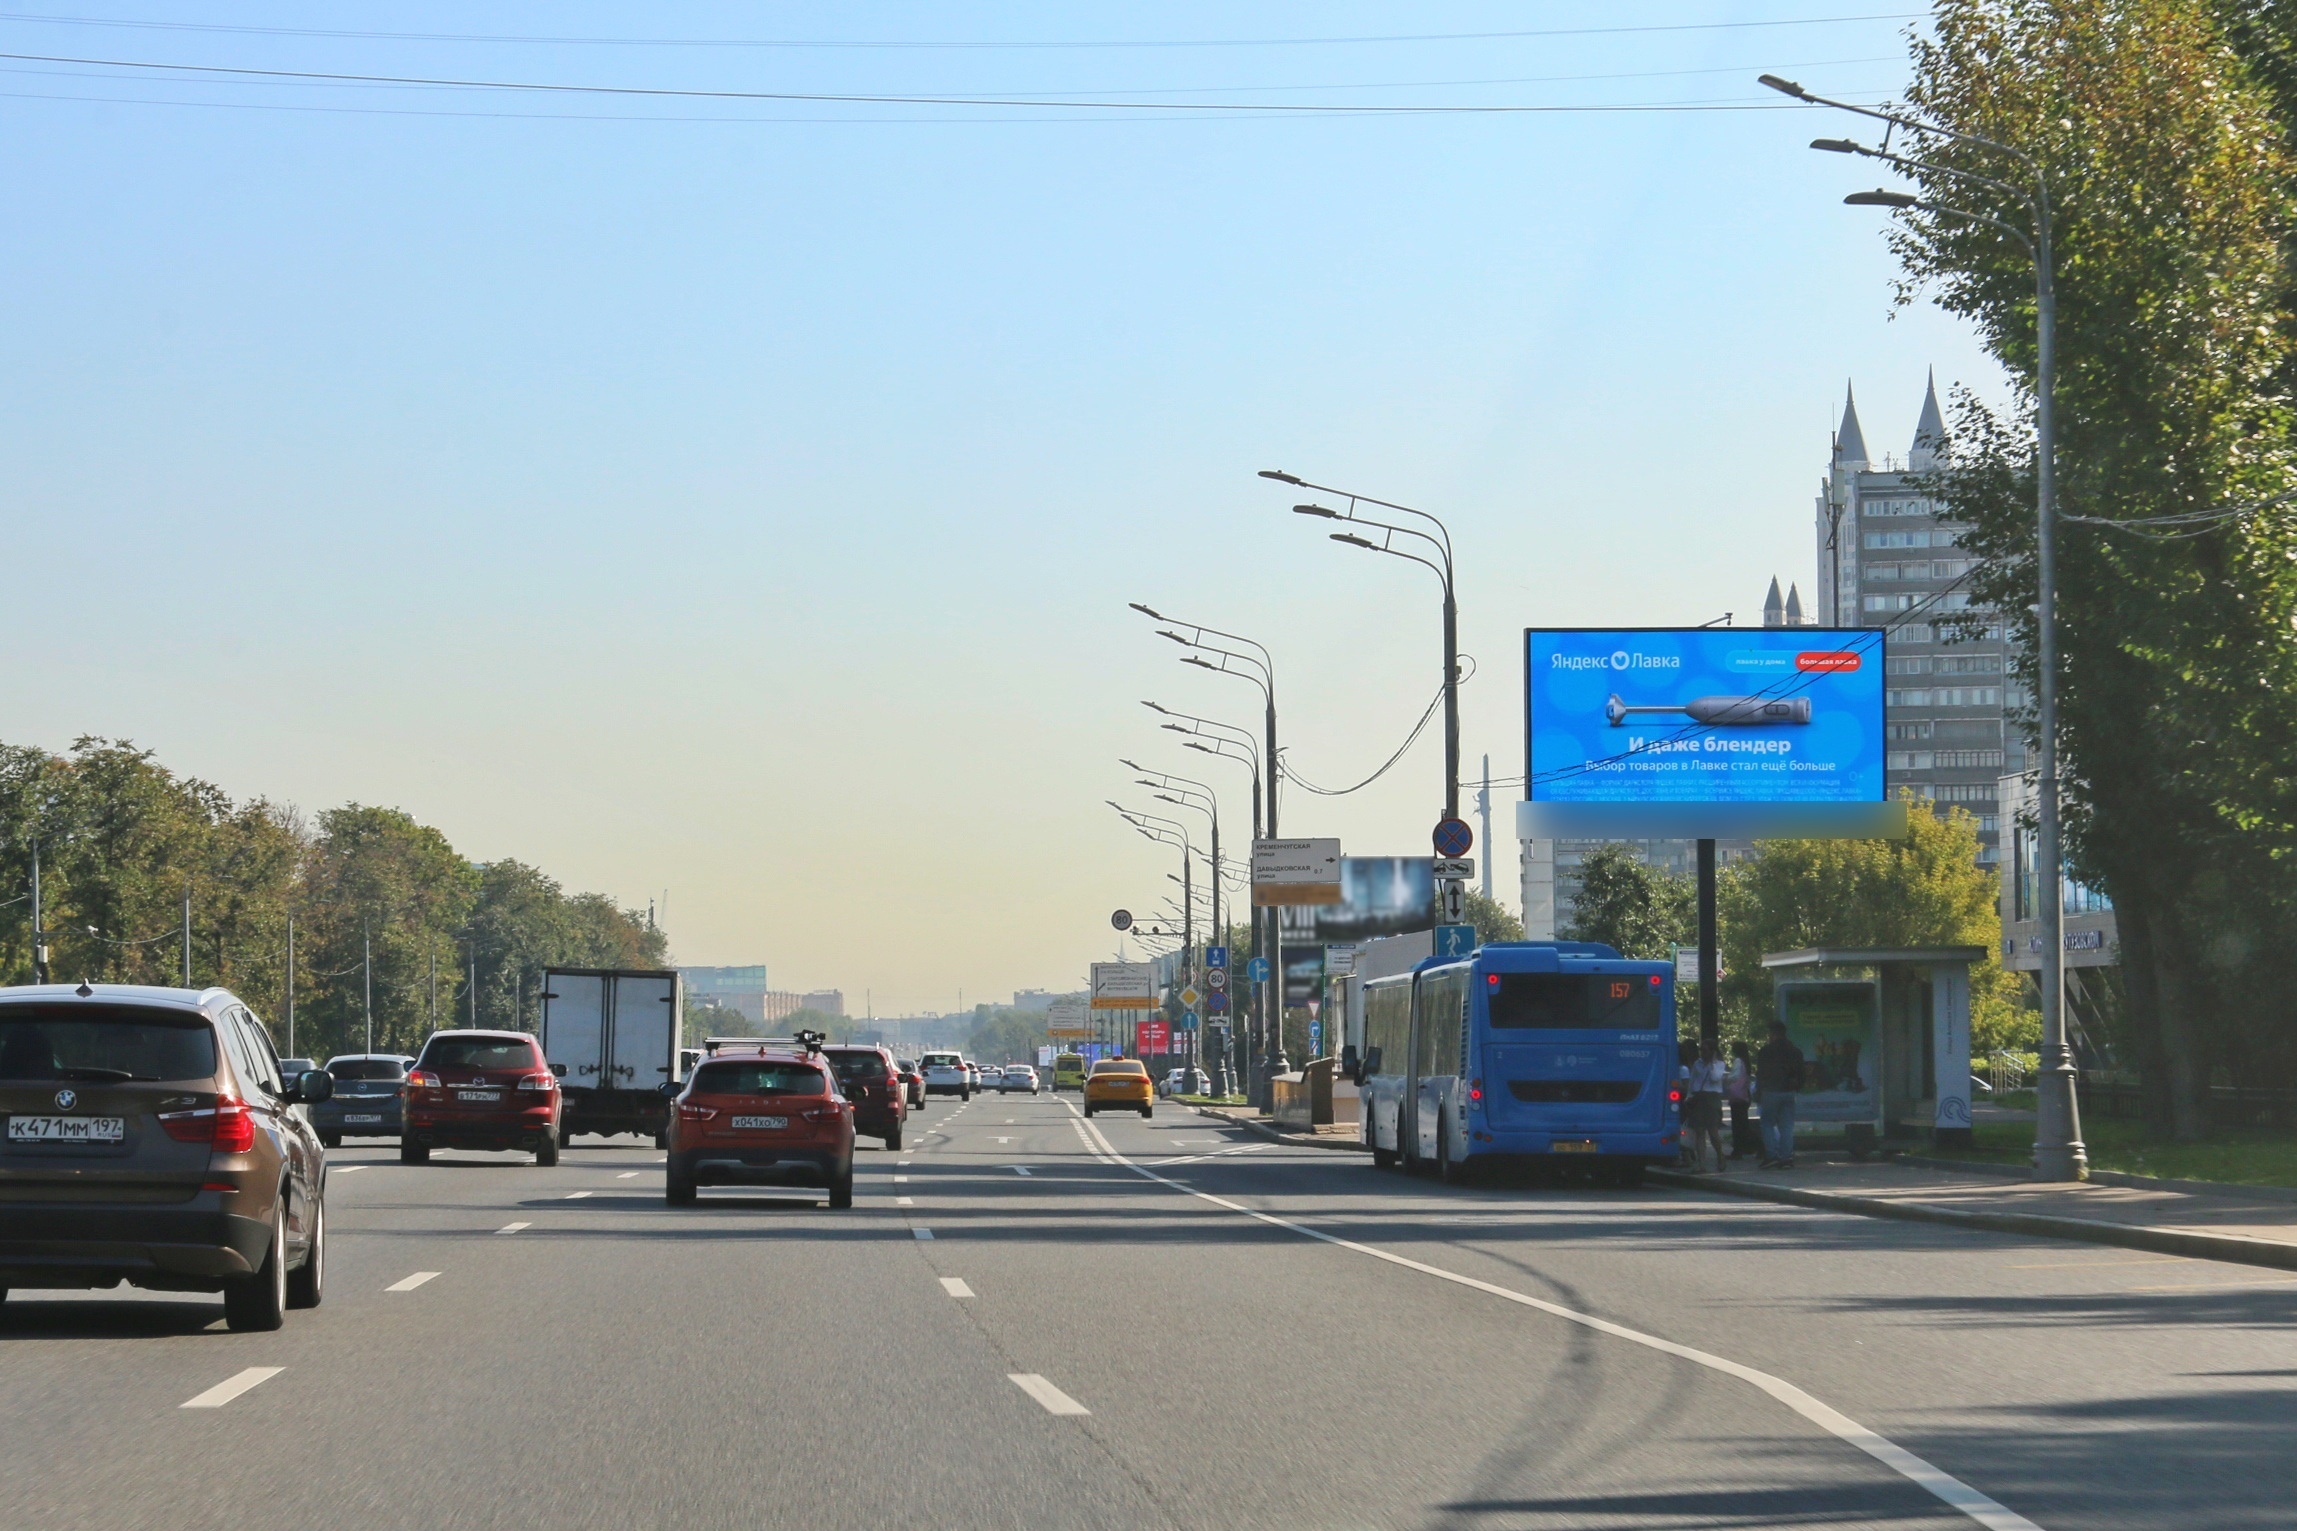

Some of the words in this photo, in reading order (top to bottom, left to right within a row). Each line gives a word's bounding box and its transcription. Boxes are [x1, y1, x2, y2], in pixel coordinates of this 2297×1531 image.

[1551, 653, 1609, 670] Яндекс
[1631, 652, 1680, 668] Лавка
[1629, 737, 1643, 752] И
[1647, 738, 1700, 755] даже
[1704, 736, 1791, 754] блендер
[1585, 760, 1626, 772] Выбор
[1629, 762, 1679, 772] товаров
[1681, 762, 1688, 771] в
[1691, 760, 1728, 771] Лавке
[1731, 762, 1758, 771] стал
[1761, 760, 1786, 772] ещё
[1789, 759, 1836, 771] больше
[1116, 915, 1128, 925] 80
[1211, 974, 1223, 984] 80
[1611, 983, 1630, 998] 157
[92, 1118, 119, 1133] 197
